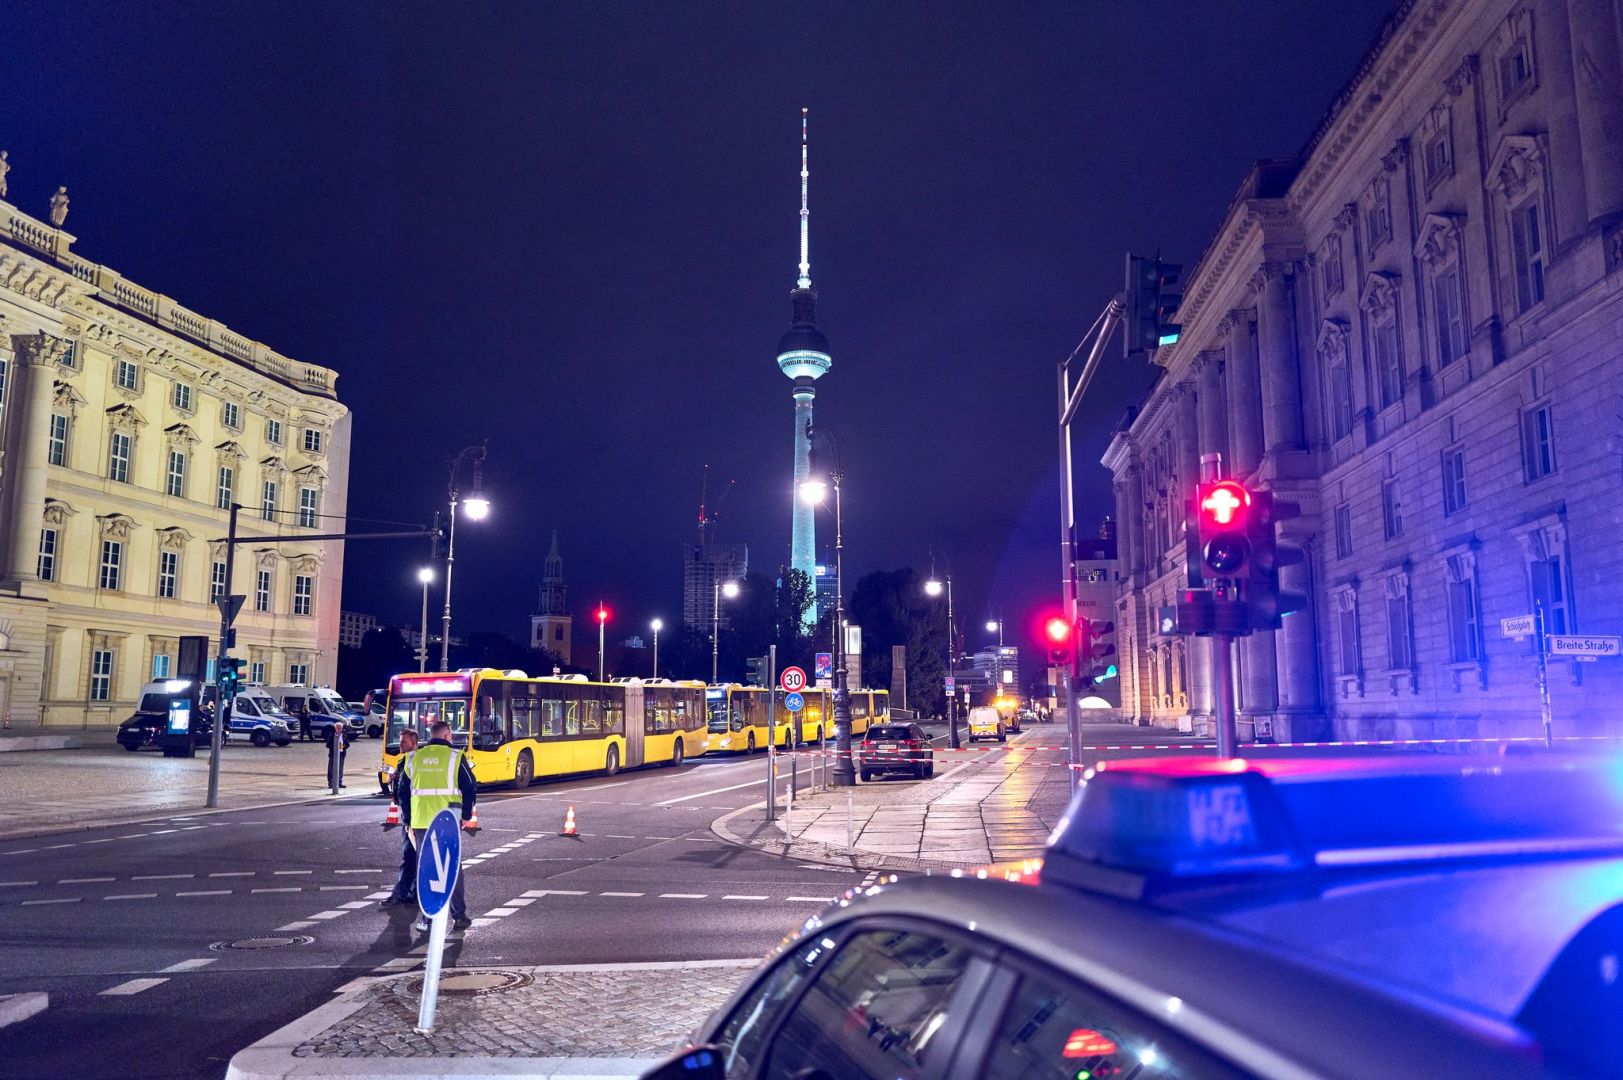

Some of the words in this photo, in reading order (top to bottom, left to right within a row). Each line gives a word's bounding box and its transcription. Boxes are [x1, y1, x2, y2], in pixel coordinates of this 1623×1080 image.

[1557, 639, 1583, 650] Breite
[1584, 640, 1614, 653] Straße
[786, 673, 801, 686] 30
